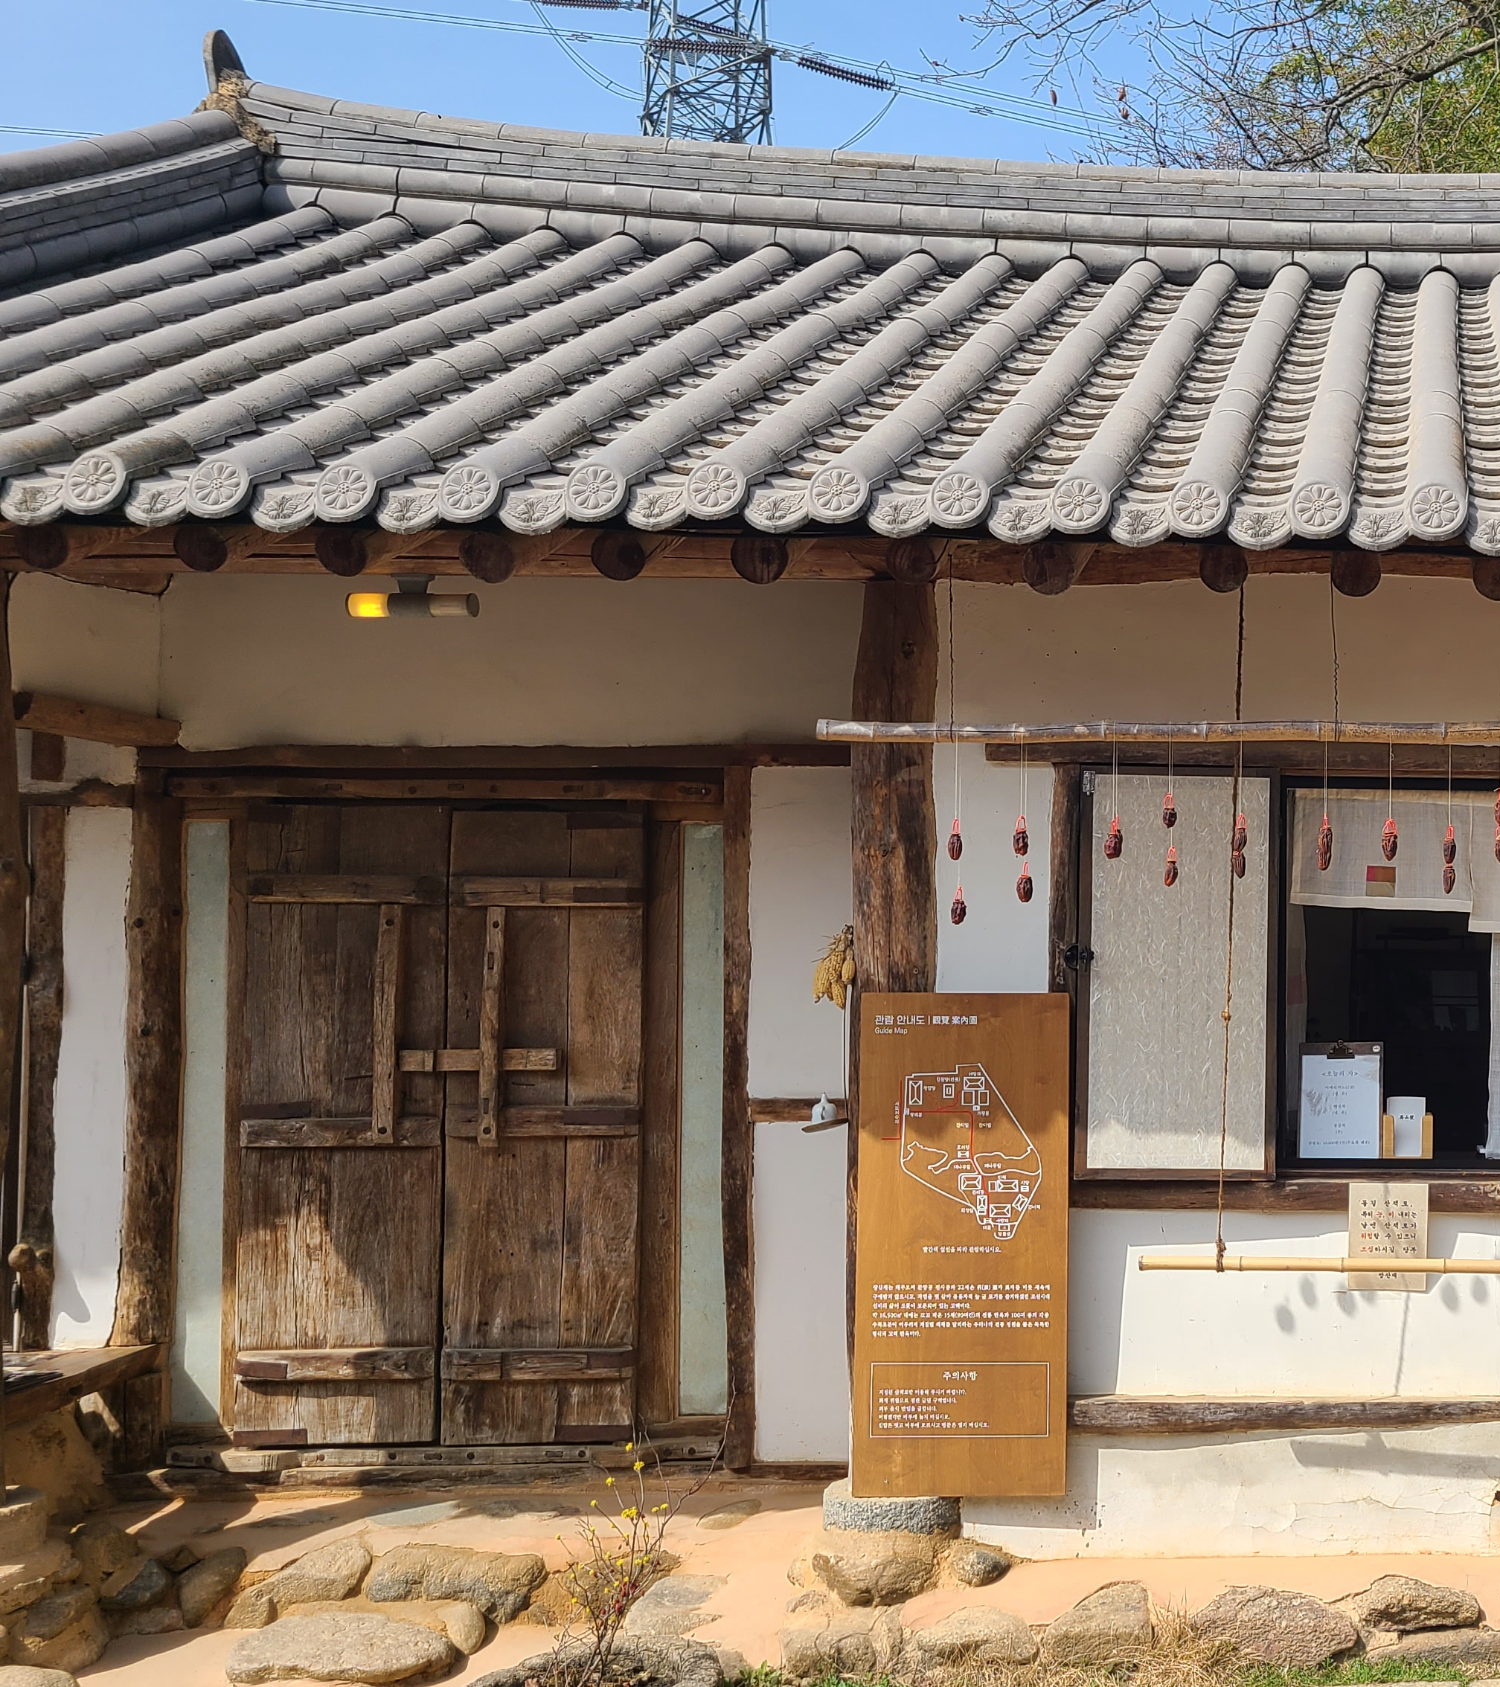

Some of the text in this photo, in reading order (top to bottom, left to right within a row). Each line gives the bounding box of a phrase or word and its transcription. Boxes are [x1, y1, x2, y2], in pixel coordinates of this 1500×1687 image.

[875, 1015, 925, 1025] 관람 안내도
[942, 1371, 978, 1381] 주의사항
